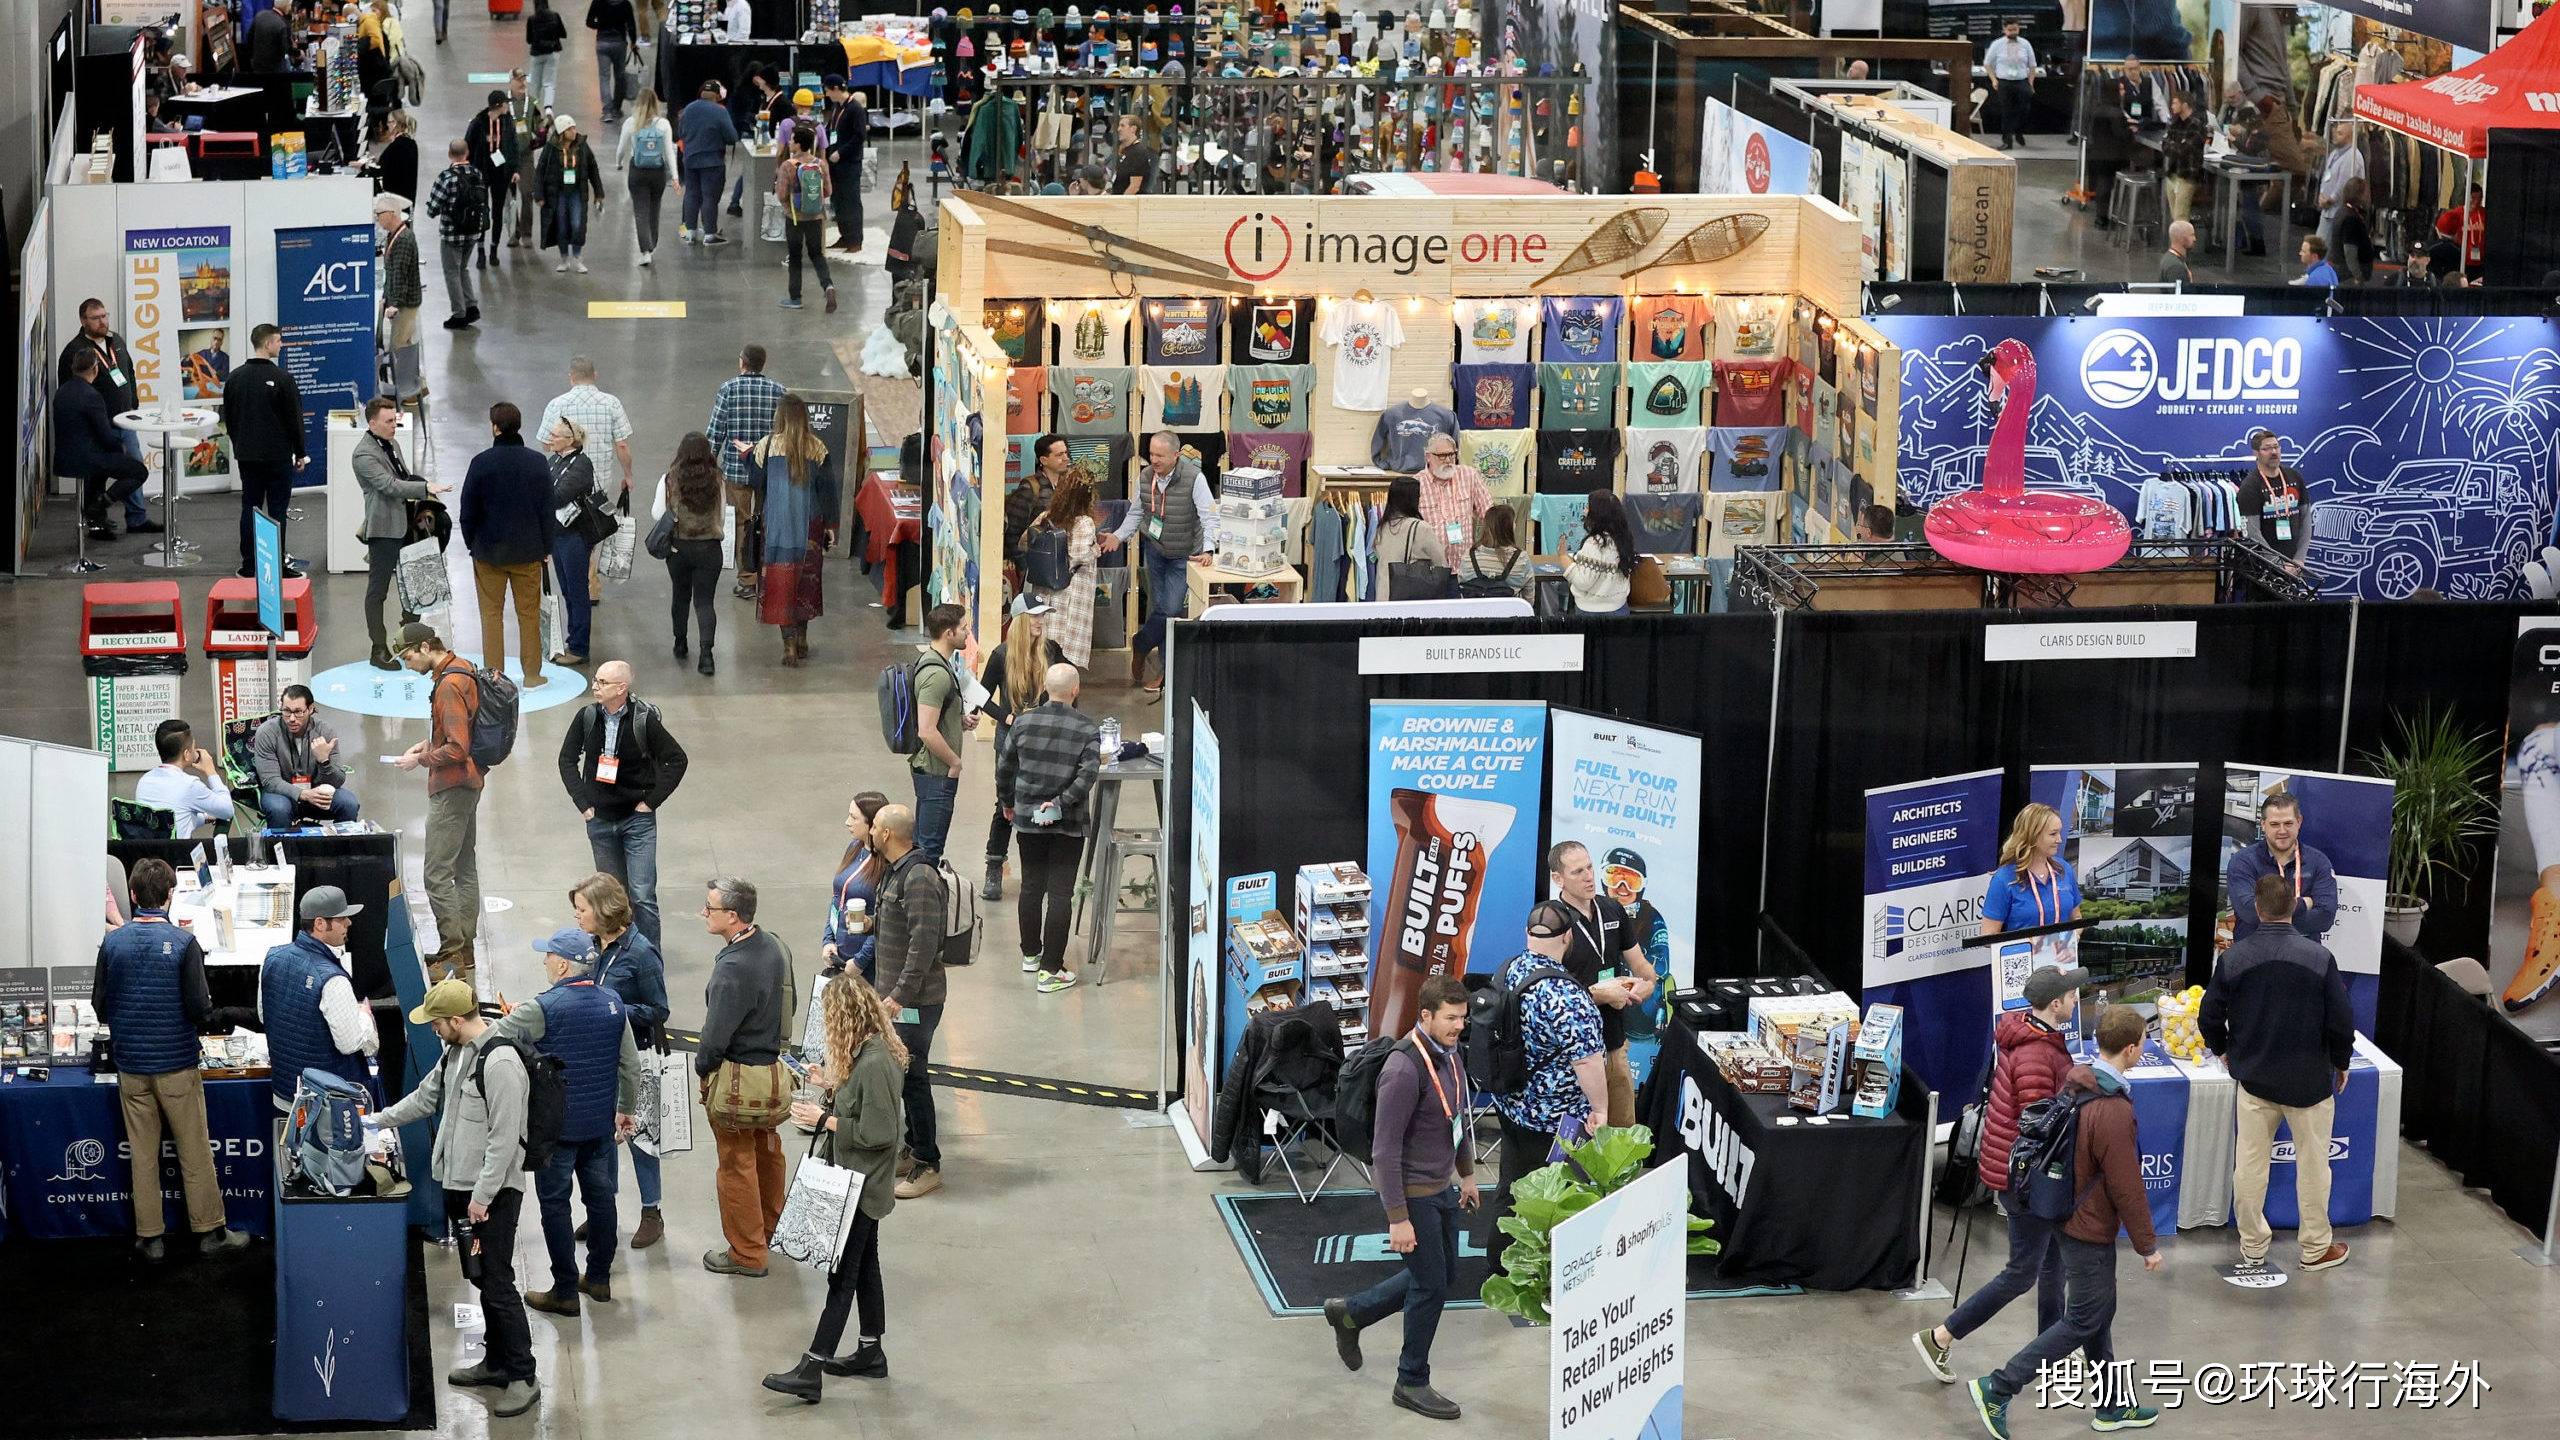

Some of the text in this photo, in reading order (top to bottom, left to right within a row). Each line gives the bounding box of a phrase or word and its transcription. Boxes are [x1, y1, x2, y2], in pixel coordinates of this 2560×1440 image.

[2356, 94, 2382, 117] Coffee
[2383, 107, 2405, 126] never
[2432, 127, 2443, 139] so
[2443, 126, 2465, 149] good.
[133, 236, 219, 249] NEW LOCATION
[1973, 186, 1991, 281] syoucan
[1305, 222, 1547, 276] image one
[304, 261, 368, 295] ACT
[134, 256, 161, 402] PRAGUE
[2157, 337, 2302, 401] JEDCO
[2156, 404, 2298, 415] JOURNEY EXPLORE DISCOVER
[1558, 457, 1597, 466] CRATER LAKE
[1225, 478, 1253, 487] STICKERS
[1648, 484, 1678, 493] MONTANA
[102, 636, 166, 646] RECYCLING
[228, 633, 273, 643] LANDF
[2040, 634, 2145, 647] CLARIS DESIGN BUILD
[1425, 647, 1522, 661] BUILT BRANDS LLC
[116, 685, 134, 693] PAPER
[117, 723, 160, 733] METAL CA
[1402, 718, 1514, 734] BROWNIE &
[117, 743, 154, 753] PLASTICS
[1378, 736, 1538, 753] MARSHMALLOW
[1593, 733, 1618, 742] BUILT
[1391, 755, 1524, 772] MAKE A CUTE
[1417, 773, 1497, 790] COUPLE
[1574, 758, 1678, 793] FUEL YOUR
[1573, 777, 1677, 813] NEXT RUN
[1573, 795, 1677, 829] WITH BUILT!
[1892, 800, 1962, 823] ARCHITECTS
[1429, 838, 1440, 858] BAR
[1892, 827, 1958, 850] ENGINEERS
[1891, 855, 1946, 876] BUILDERS
[1238, 878, 1268, 891] BUILT
[1436, 832, 1476, 936] PUFFS
[1401, 850, 1440, 957] BUILT
[1907, 895, 1985, 932] CLARIS
[1268, 967, 1292, 979] BUILT
[1828, 1036, 1841, 1096] BUILT
[675, 1075, 684, 1141] EARTHPACK
[1679, 1076, 1756, 1210] BUILT
[2142, 1154, 2173, 1176] RIS
[2145, 1179, 2171, 1190] UILD
[47, 1192, 134, 1204] CONVENIEN
[1562, 1244, 1602, 1278] ORACLE
[1562, 1265, 1597, 1294] NETSUITE
[2238, 1275, 2277, 1283] NEW
[1562, 1294, 1636, 1353] Take Your
[1562, 1307, 1674, 1393] Retail Business
[1561, 1343, 1674, 1430] to New Heights
